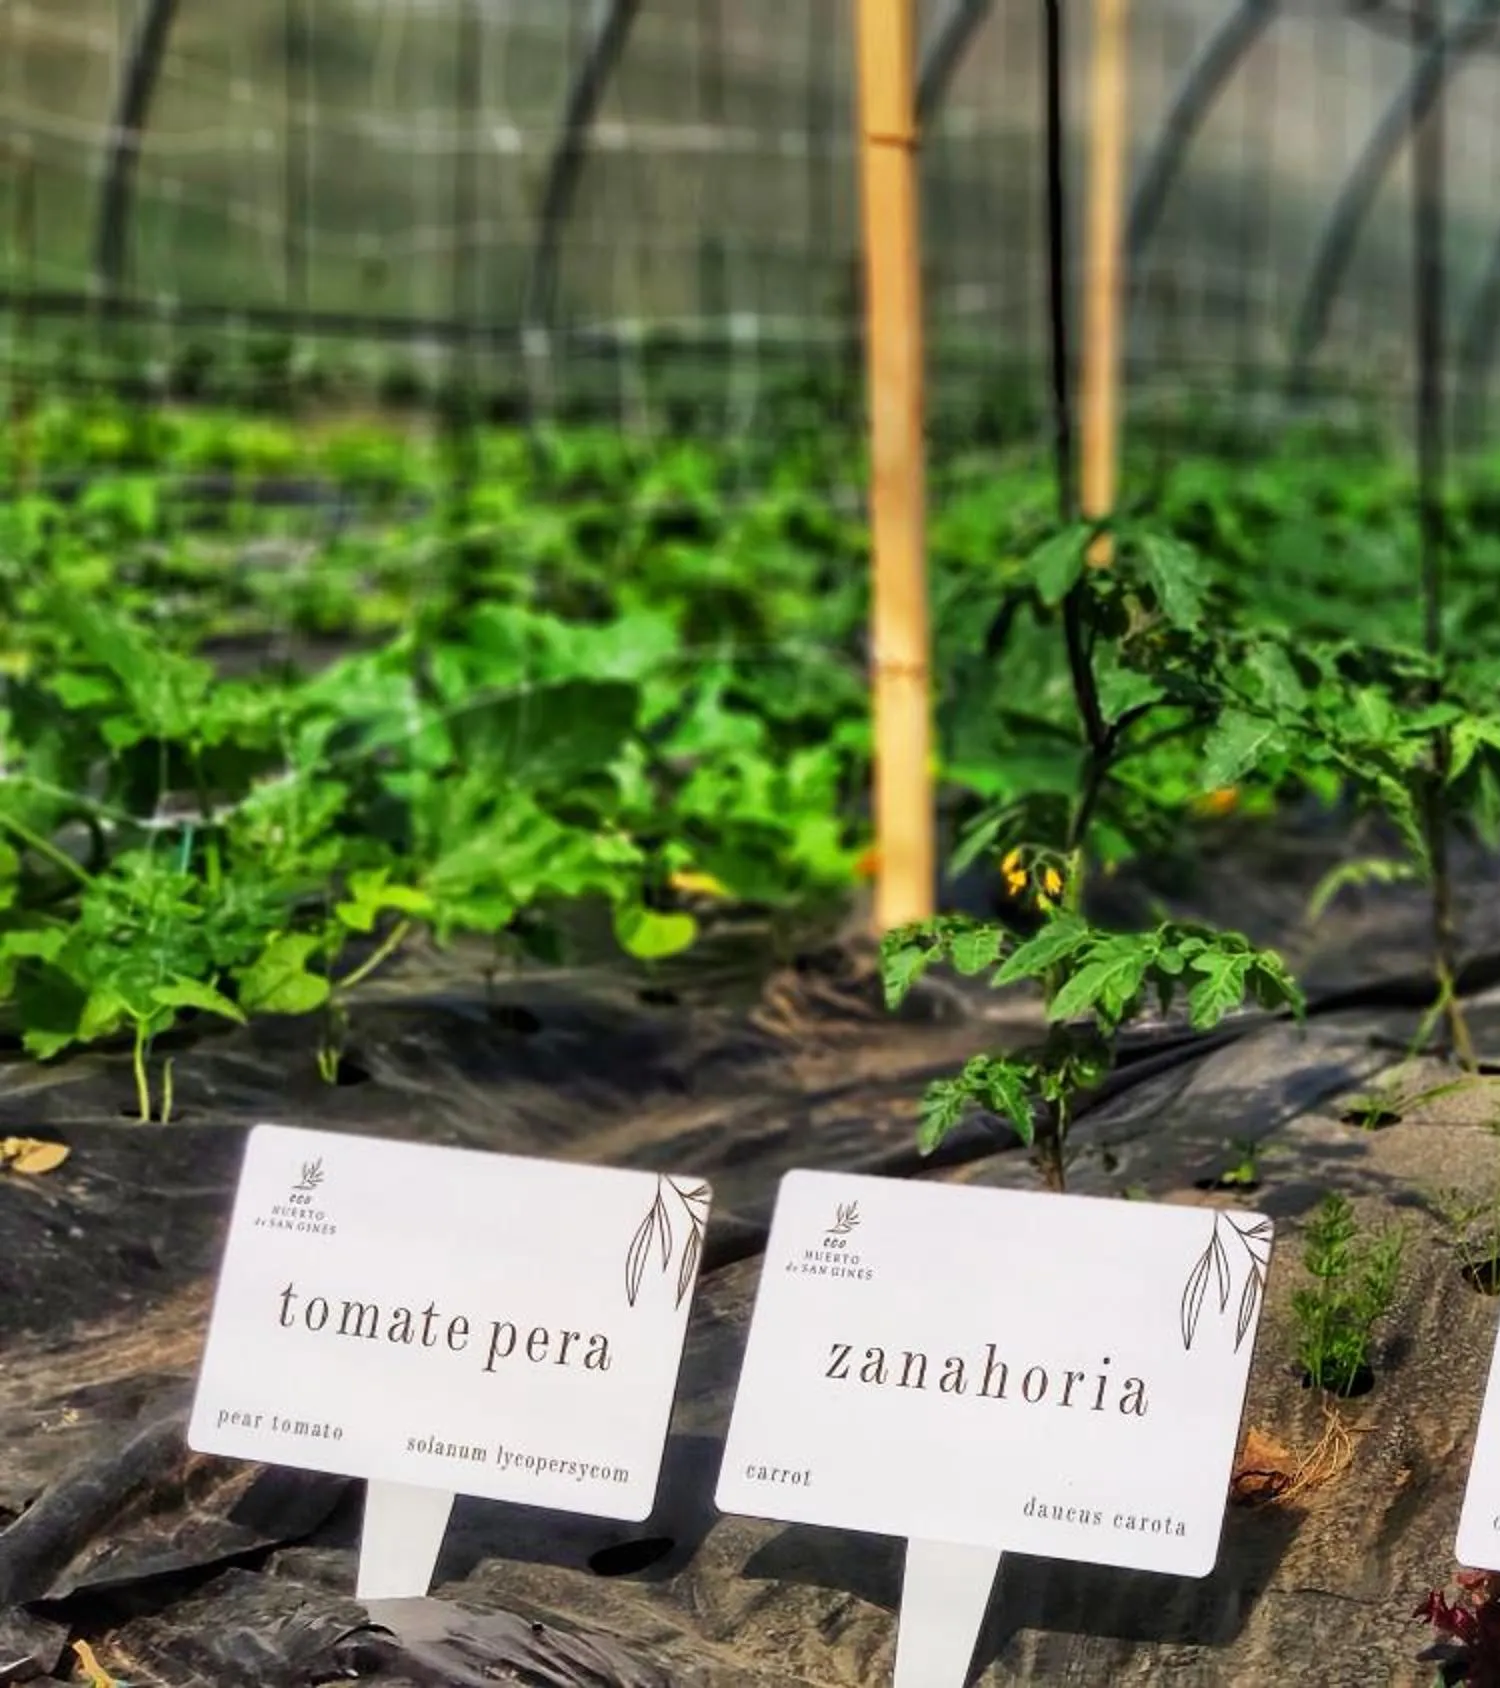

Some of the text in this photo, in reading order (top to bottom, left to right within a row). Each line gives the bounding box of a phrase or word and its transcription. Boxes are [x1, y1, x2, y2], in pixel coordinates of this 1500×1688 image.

[801, 1263, 829, 1276] SAN
[804, 1249, 861, 1265] HUERTO
[278, 1281, 613, 1373] tomate pera
[824, 1342, 1150, 1417] zanahoria
[217, 1407, 344, 1441] pear tomato
[406, 1434, 630, 1484] solanum lycopersycom
[745, 1461, 813, 1487] carrot
[1022, 1496, 1188, 1538] daucus carota
